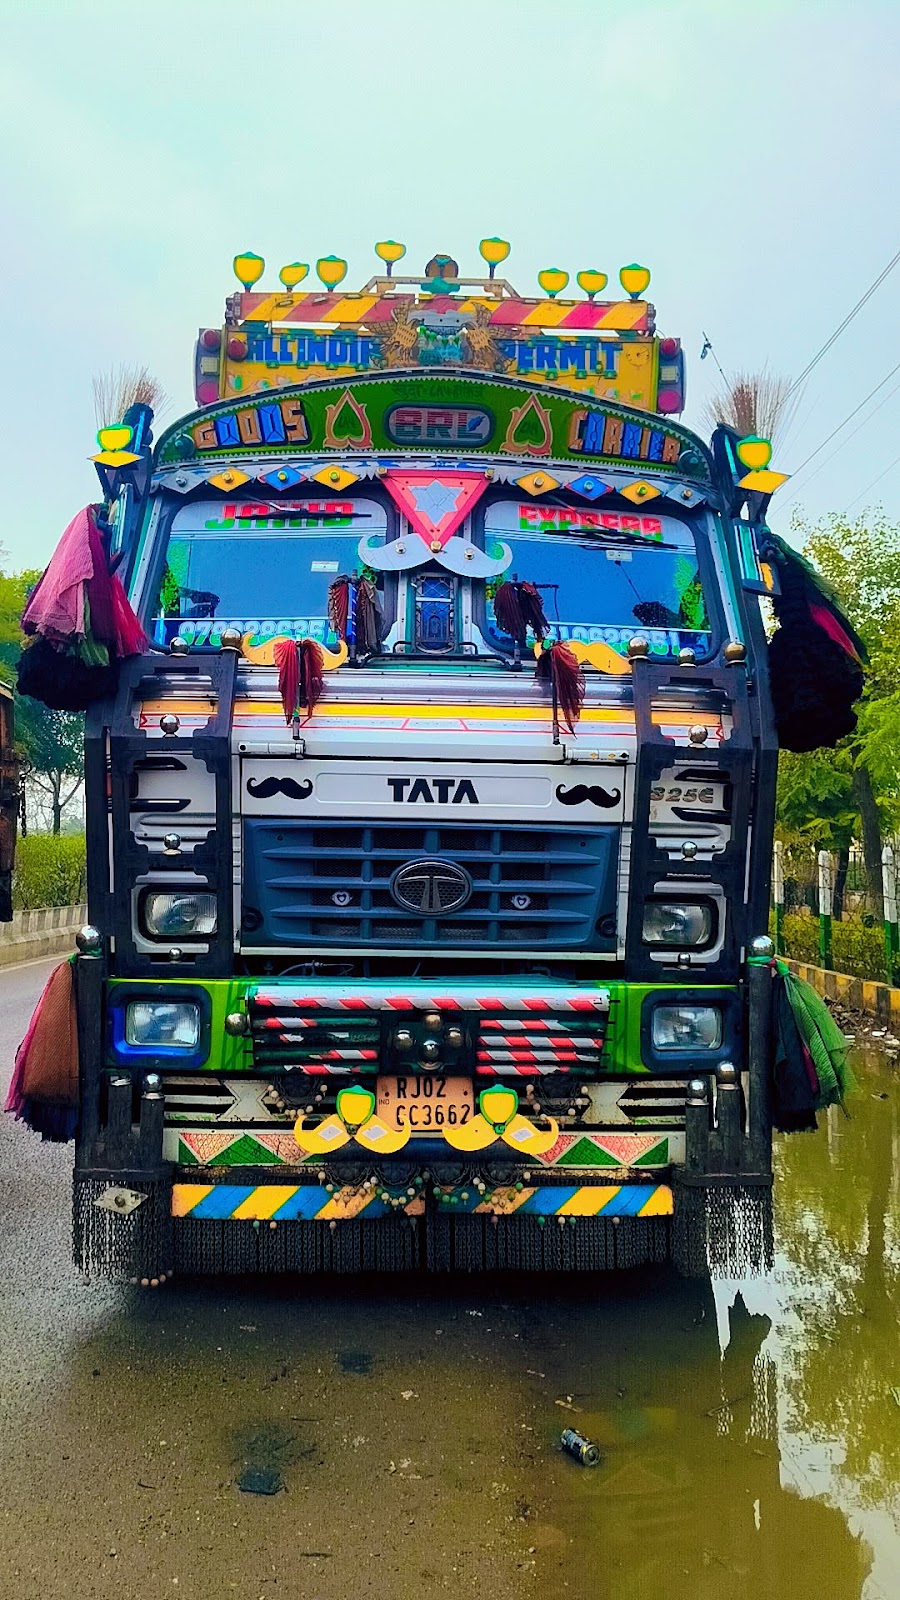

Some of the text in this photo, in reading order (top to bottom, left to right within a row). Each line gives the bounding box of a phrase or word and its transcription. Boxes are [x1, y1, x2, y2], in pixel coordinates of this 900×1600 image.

[193, 400, 681, 463] GOODS CARRIER
[395, 410, 484, 439] BRL
[387, 778, 480, 804] TATA
[396, 1076, 447, 1098] RJ02
[378, 1098, 390, 1106] IND
[396, 1104, 471, 1126] CC3662
